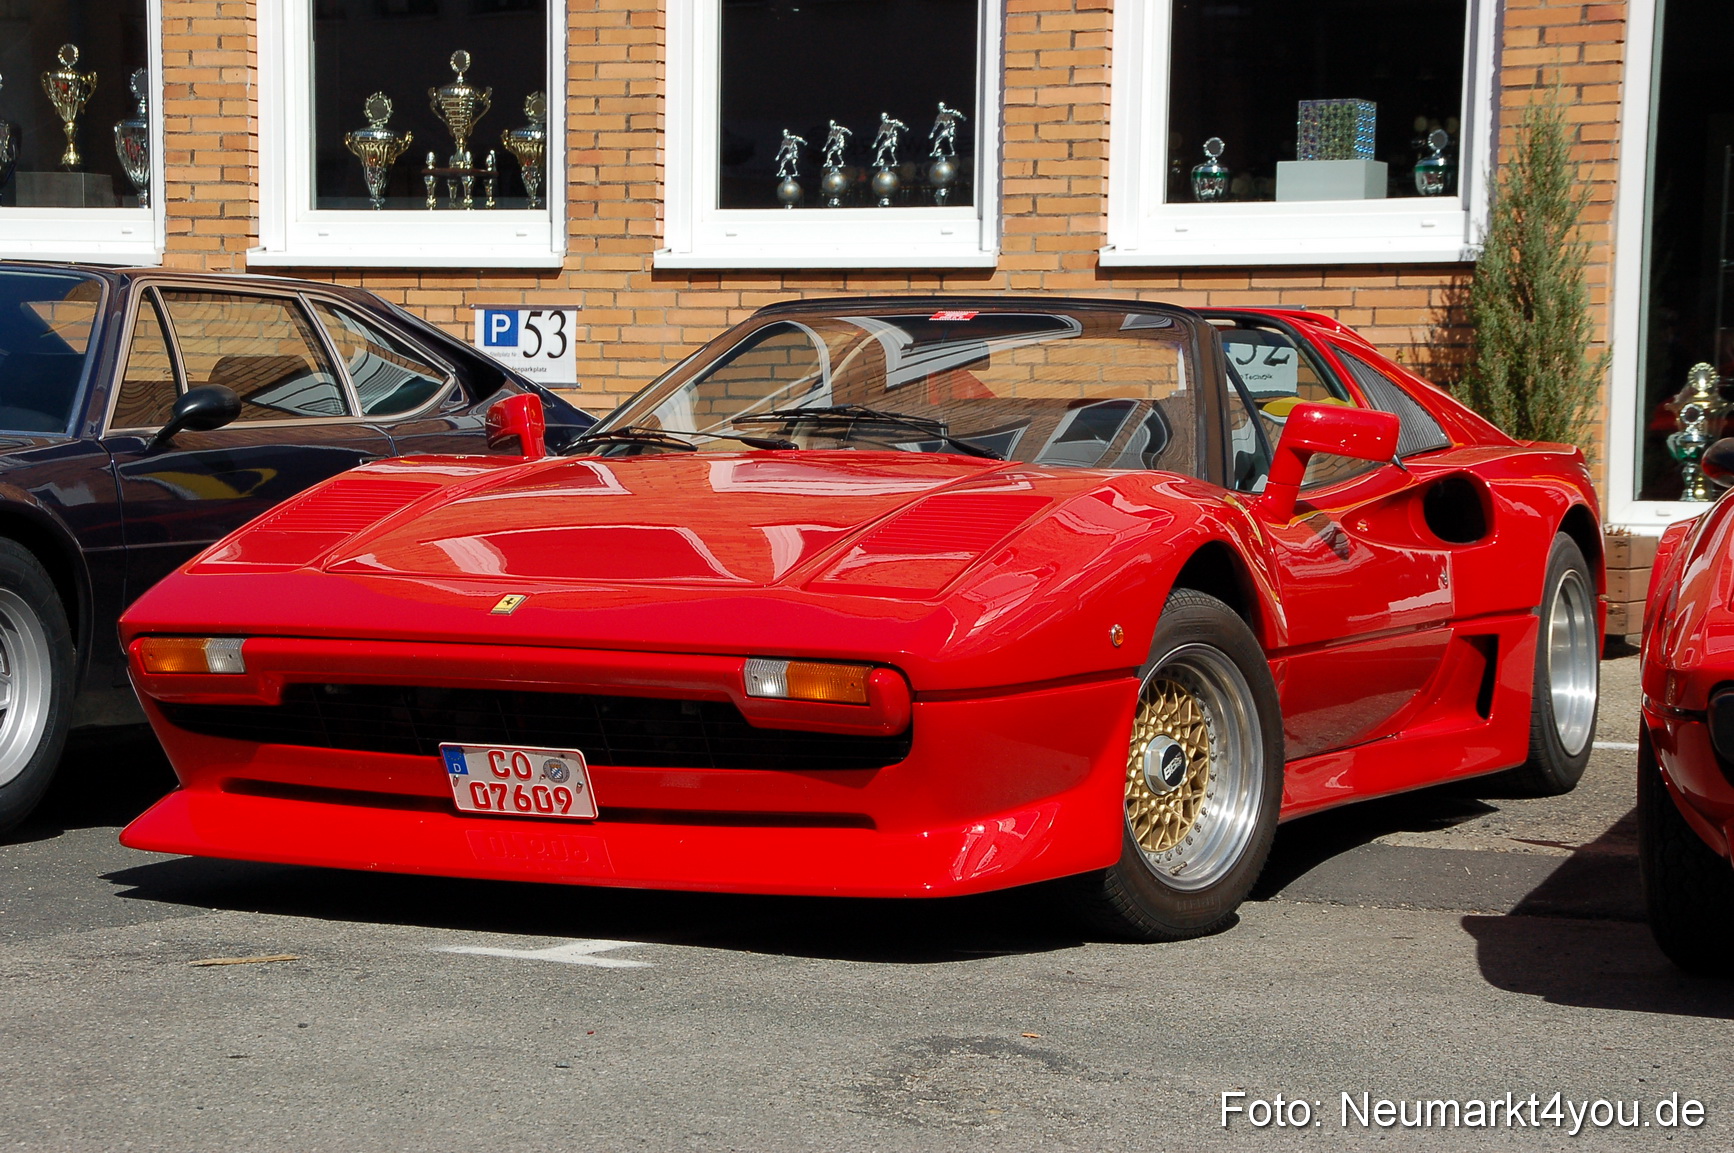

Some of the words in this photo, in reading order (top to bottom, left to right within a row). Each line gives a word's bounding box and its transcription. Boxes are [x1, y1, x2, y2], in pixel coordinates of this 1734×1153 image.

[491, 313, 511, 343] P
[523, 310, 567, 358] 53
[453, 763, 462, 773] D
[488, 750, 533, 781] CO
[1163, 751, 1182, 781] BBS
[469, 781, 573, 814] 07609
